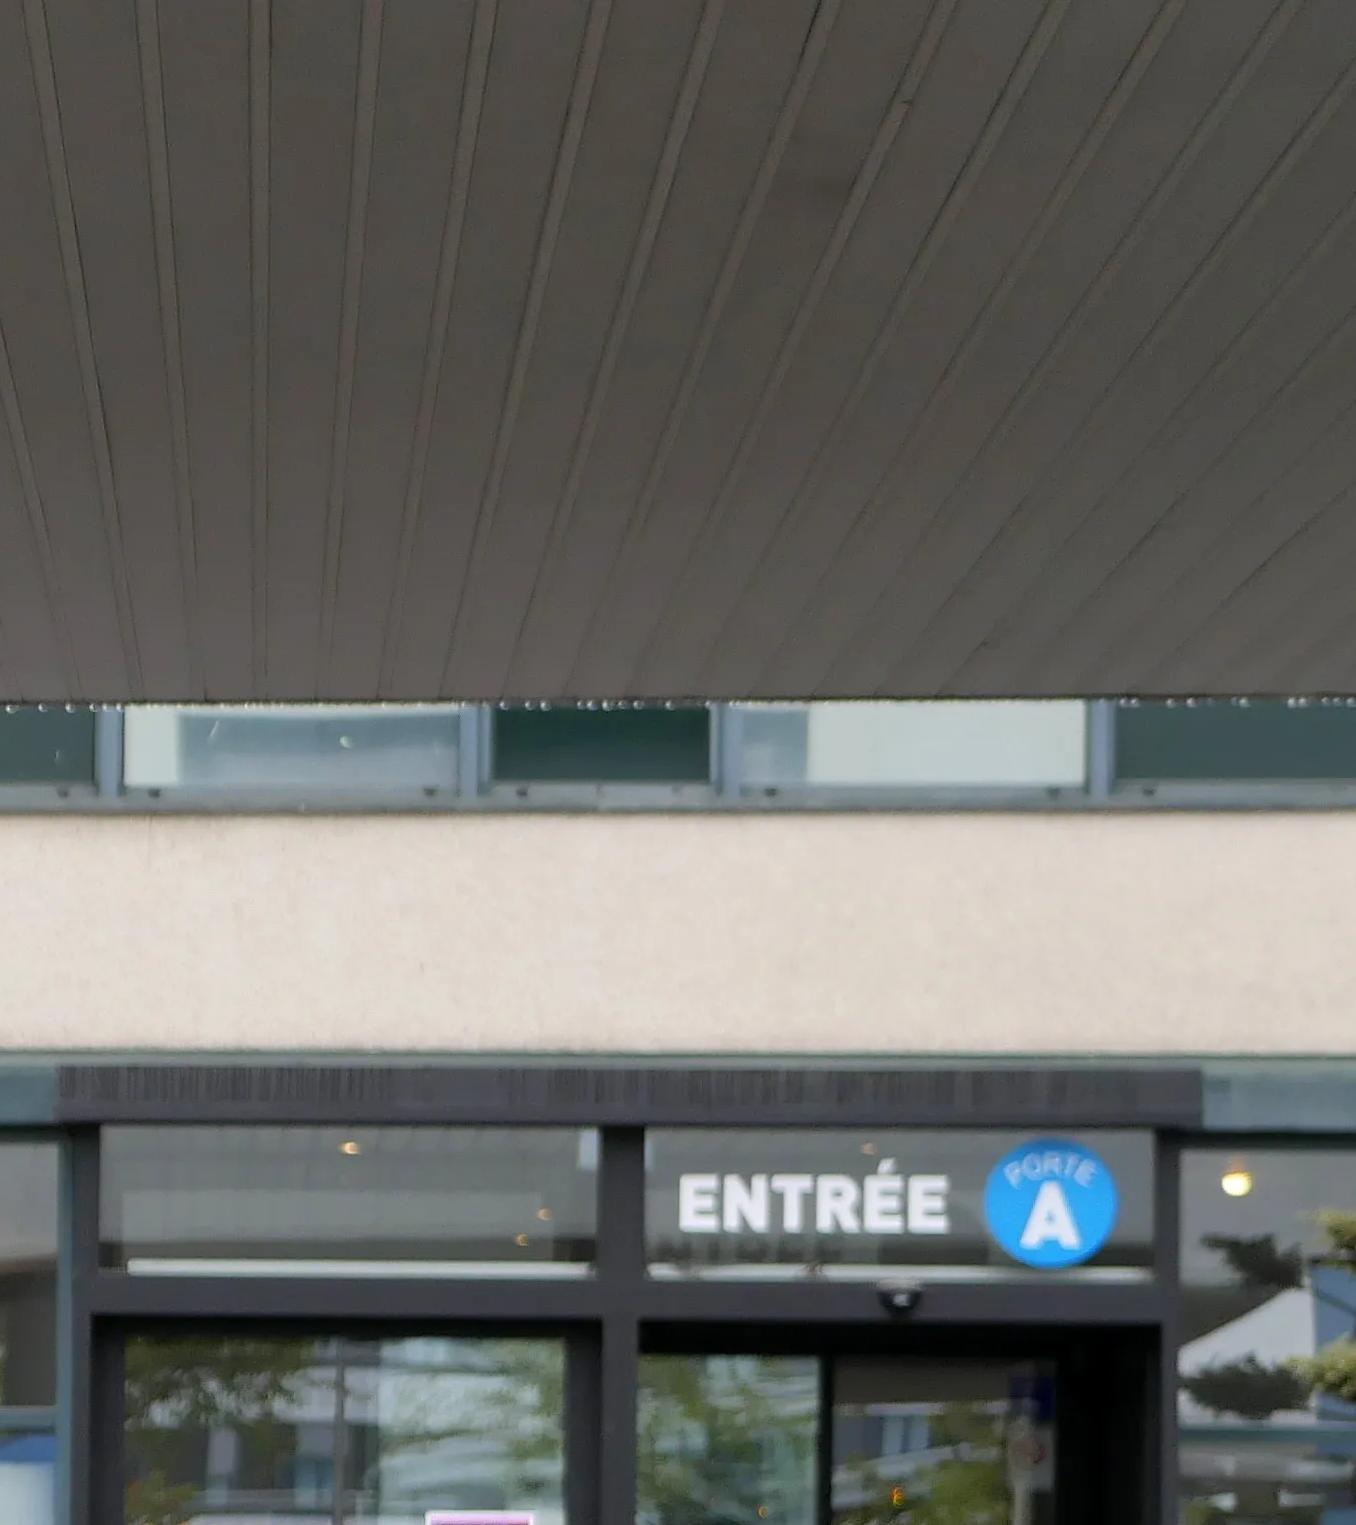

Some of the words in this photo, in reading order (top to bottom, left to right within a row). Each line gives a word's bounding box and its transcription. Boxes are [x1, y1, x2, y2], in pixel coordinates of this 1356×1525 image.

[678, 1157, 951, 1234] ENTRÉE
[1003, 1152, 1098, 1190] PORTE
[1020, 1180, 1082, 1251] A
